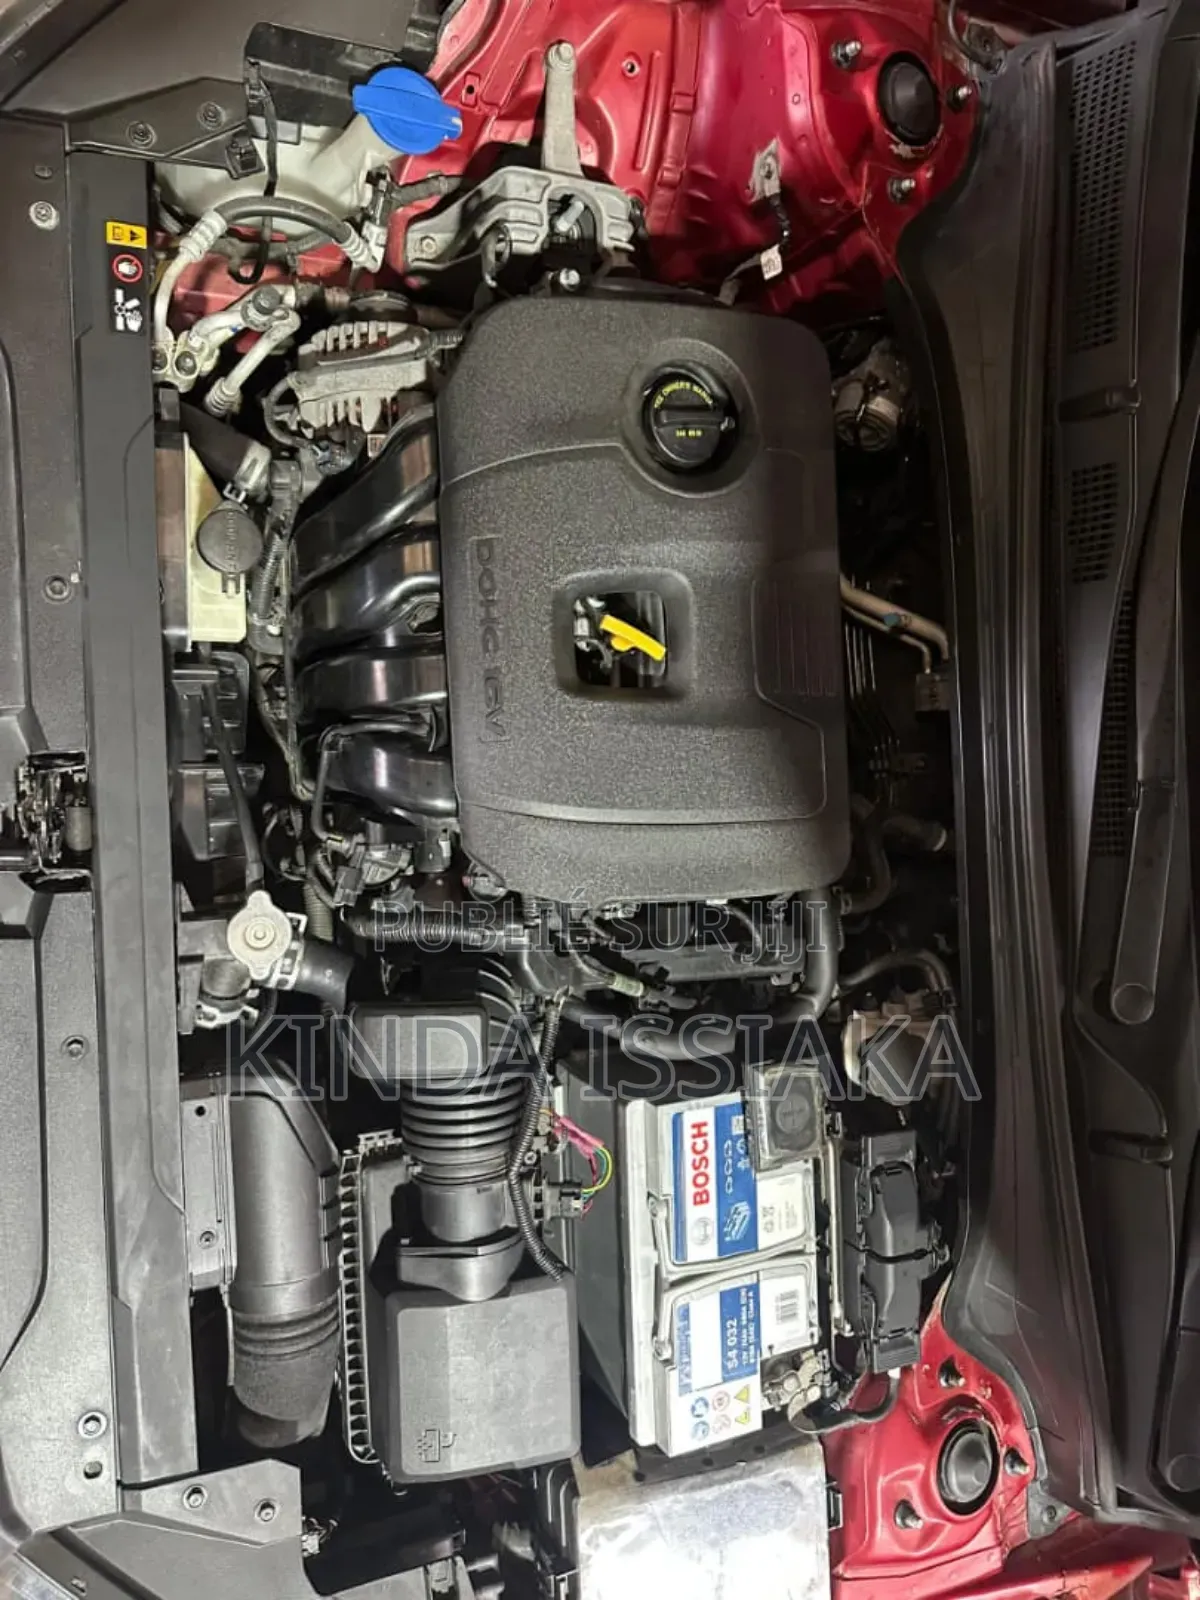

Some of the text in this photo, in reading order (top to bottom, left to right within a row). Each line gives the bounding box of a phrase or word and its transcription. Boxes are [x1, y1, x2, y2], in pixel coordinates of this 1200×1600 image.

[476, 538, 500, 656] DOHC
[690, 1121, 711, 1206] BOSCH
[725, 1318, 739, 1371] S4 032
